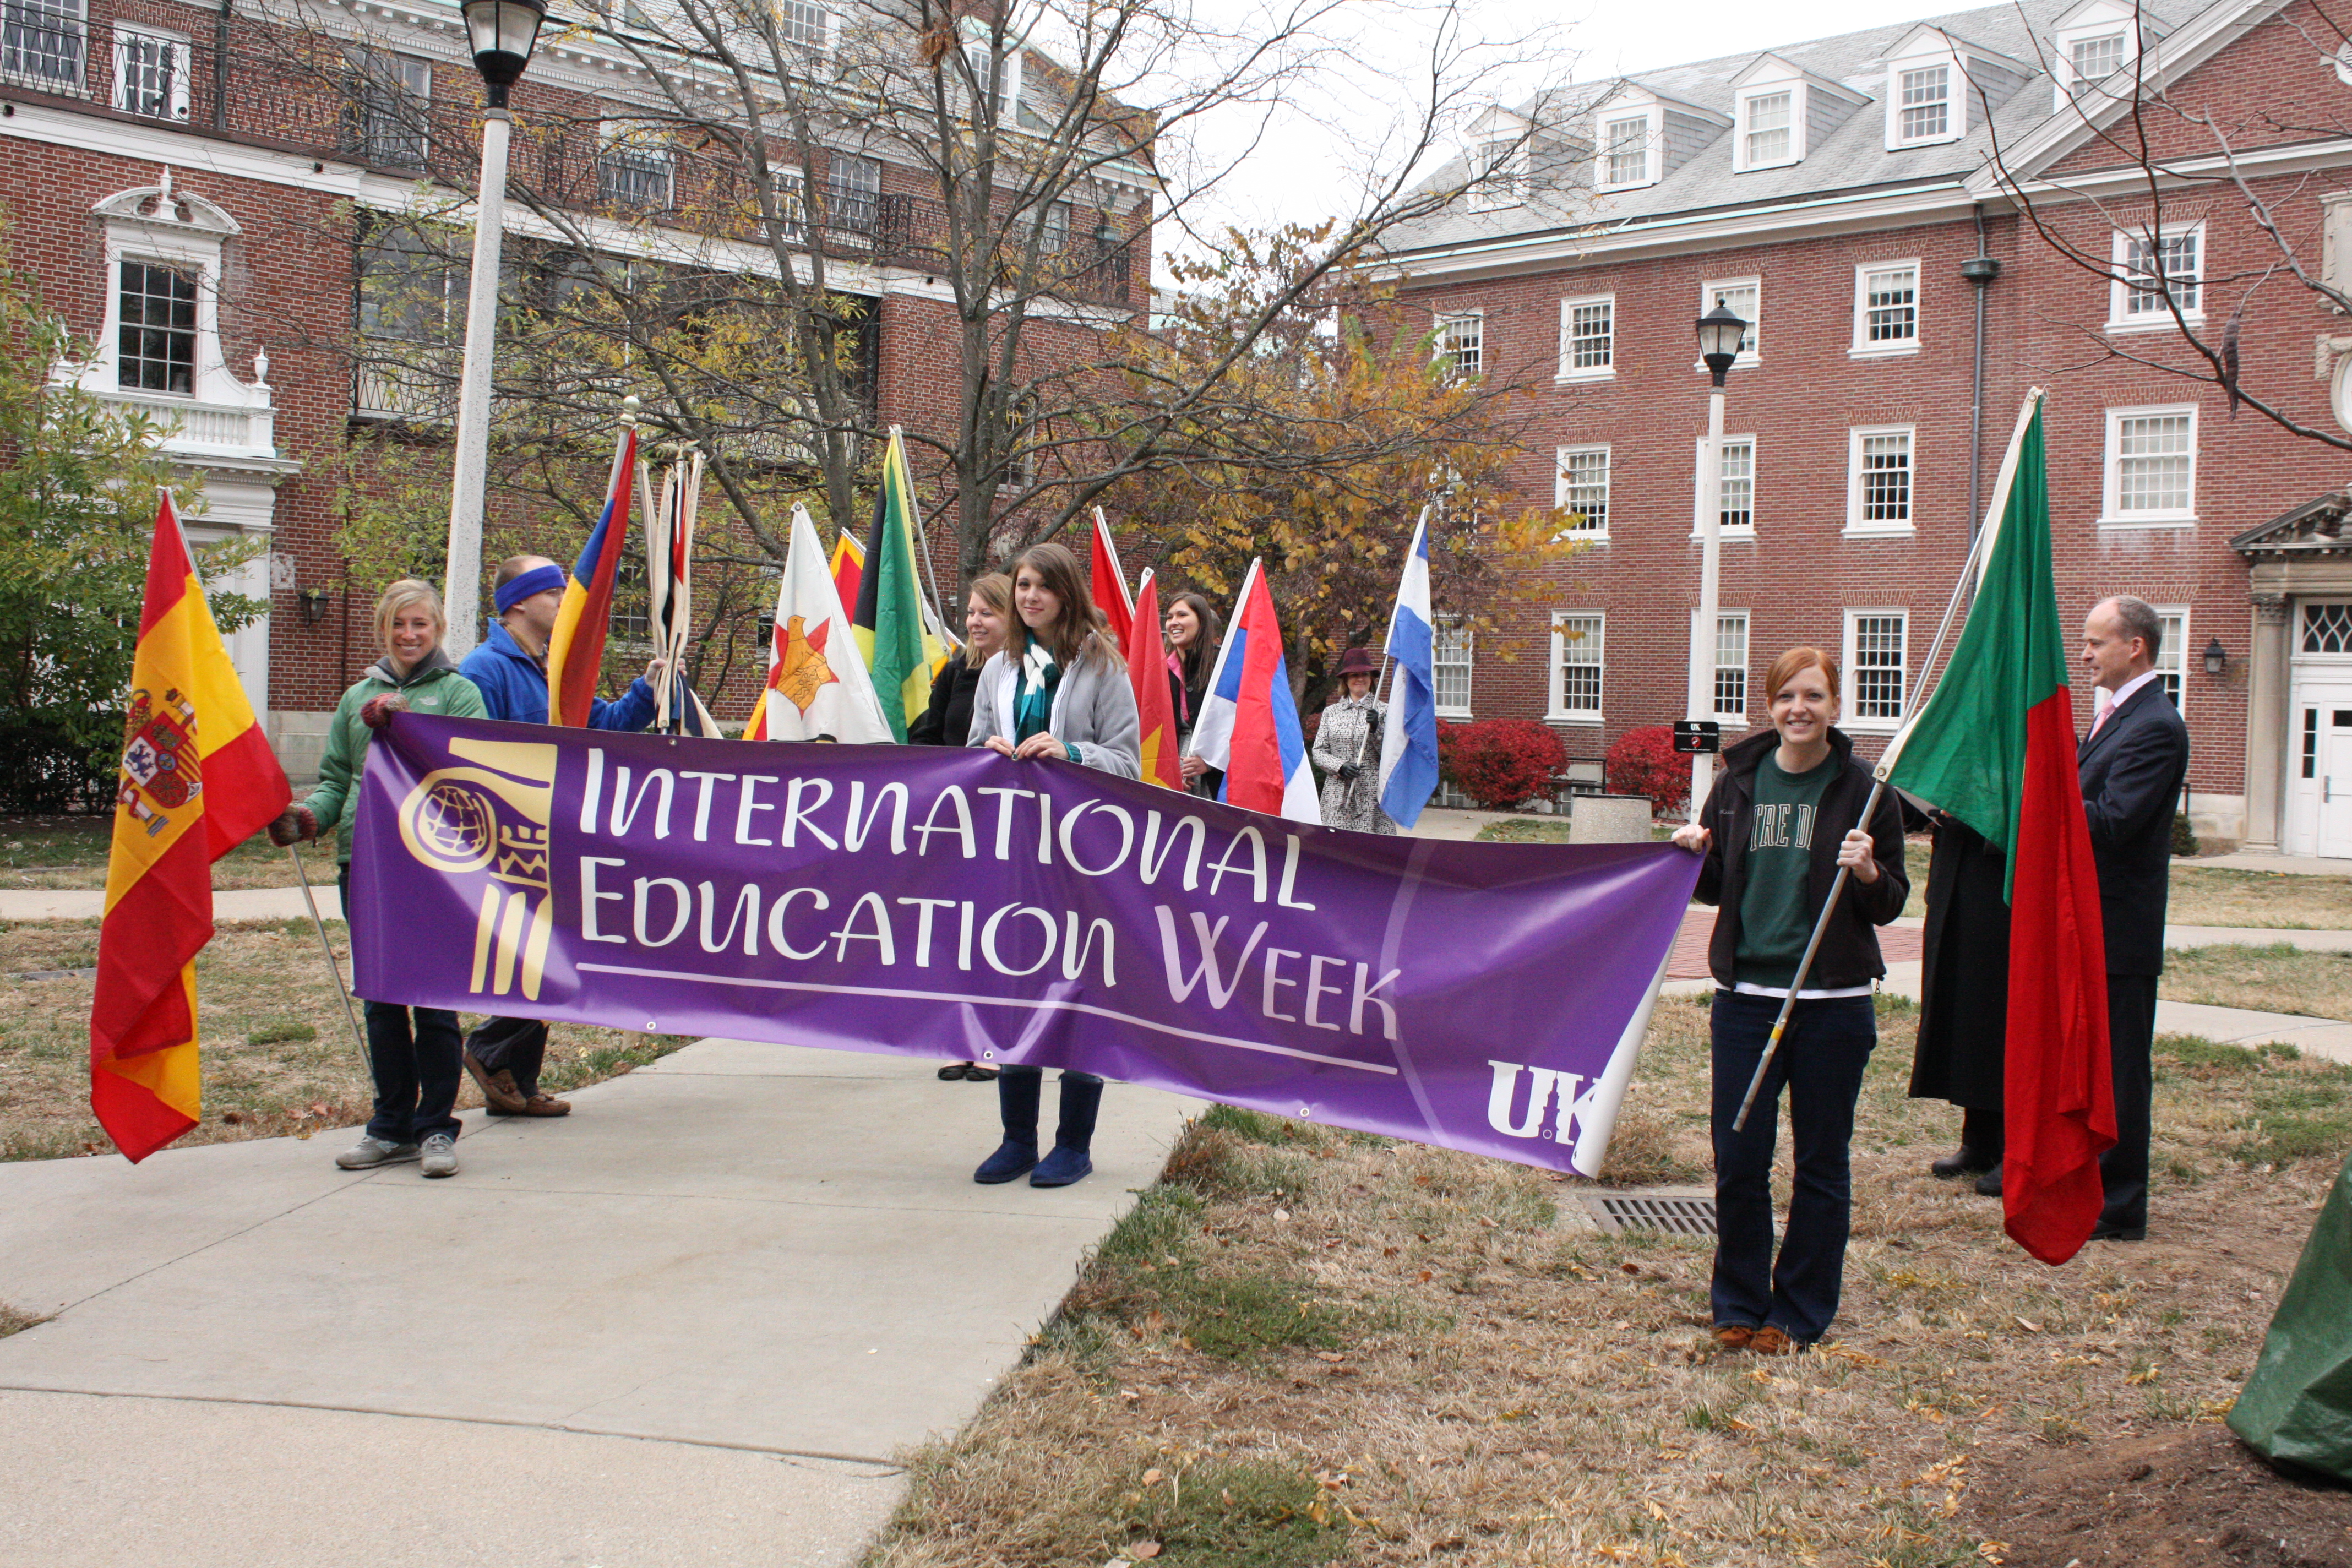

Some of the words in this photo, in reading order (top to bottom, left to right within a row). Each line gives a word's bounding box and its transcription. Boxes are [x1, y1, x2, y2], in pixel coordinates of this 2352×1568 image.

[1690, 723, 1701, 731] UK
[1795, 804, 1818, 851] D
[580, 856, 1117, 988] EDUCATION
[1154, 905, 1402, 1041] WEEK
[1487, 1059, 1601, 1146] UK
